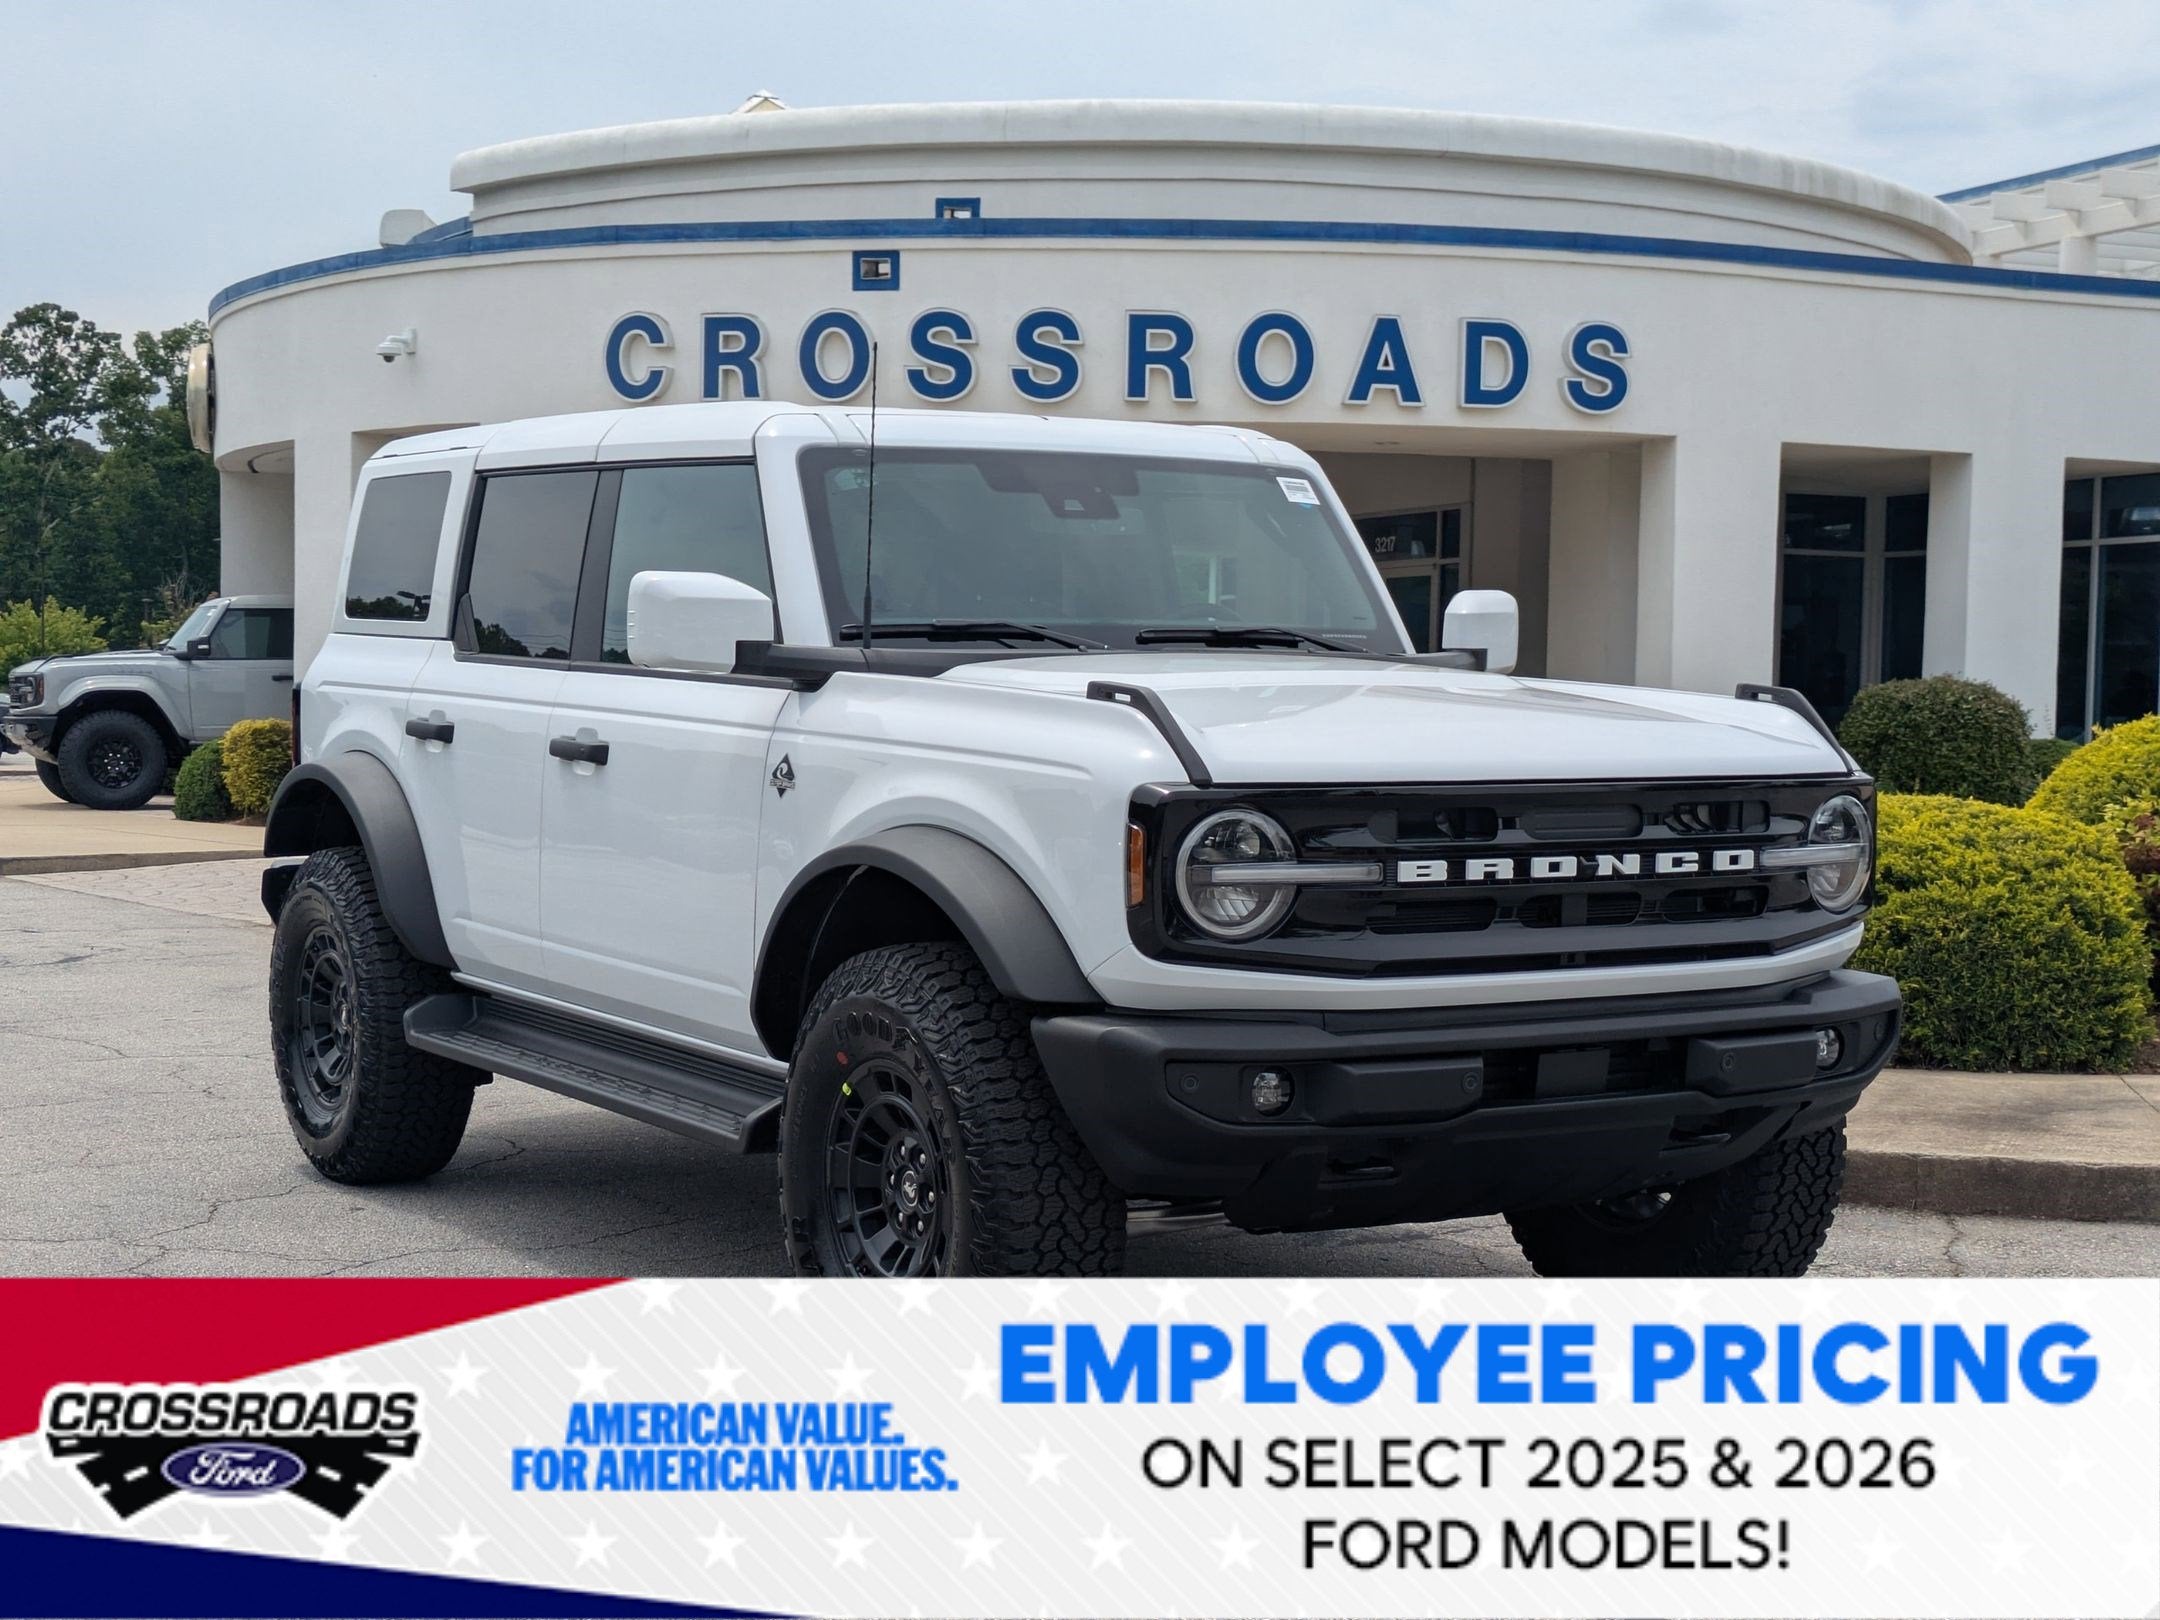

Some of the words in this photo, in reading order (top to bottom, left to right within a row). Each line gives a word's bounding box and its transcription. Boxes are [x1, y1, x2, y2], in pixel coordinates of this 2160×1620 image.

[606, 309, 1631, 414] CROSSROADS
[1375, 536, 1396, 552] 3217
[1397, 849, 1755, 882] BRONCO
